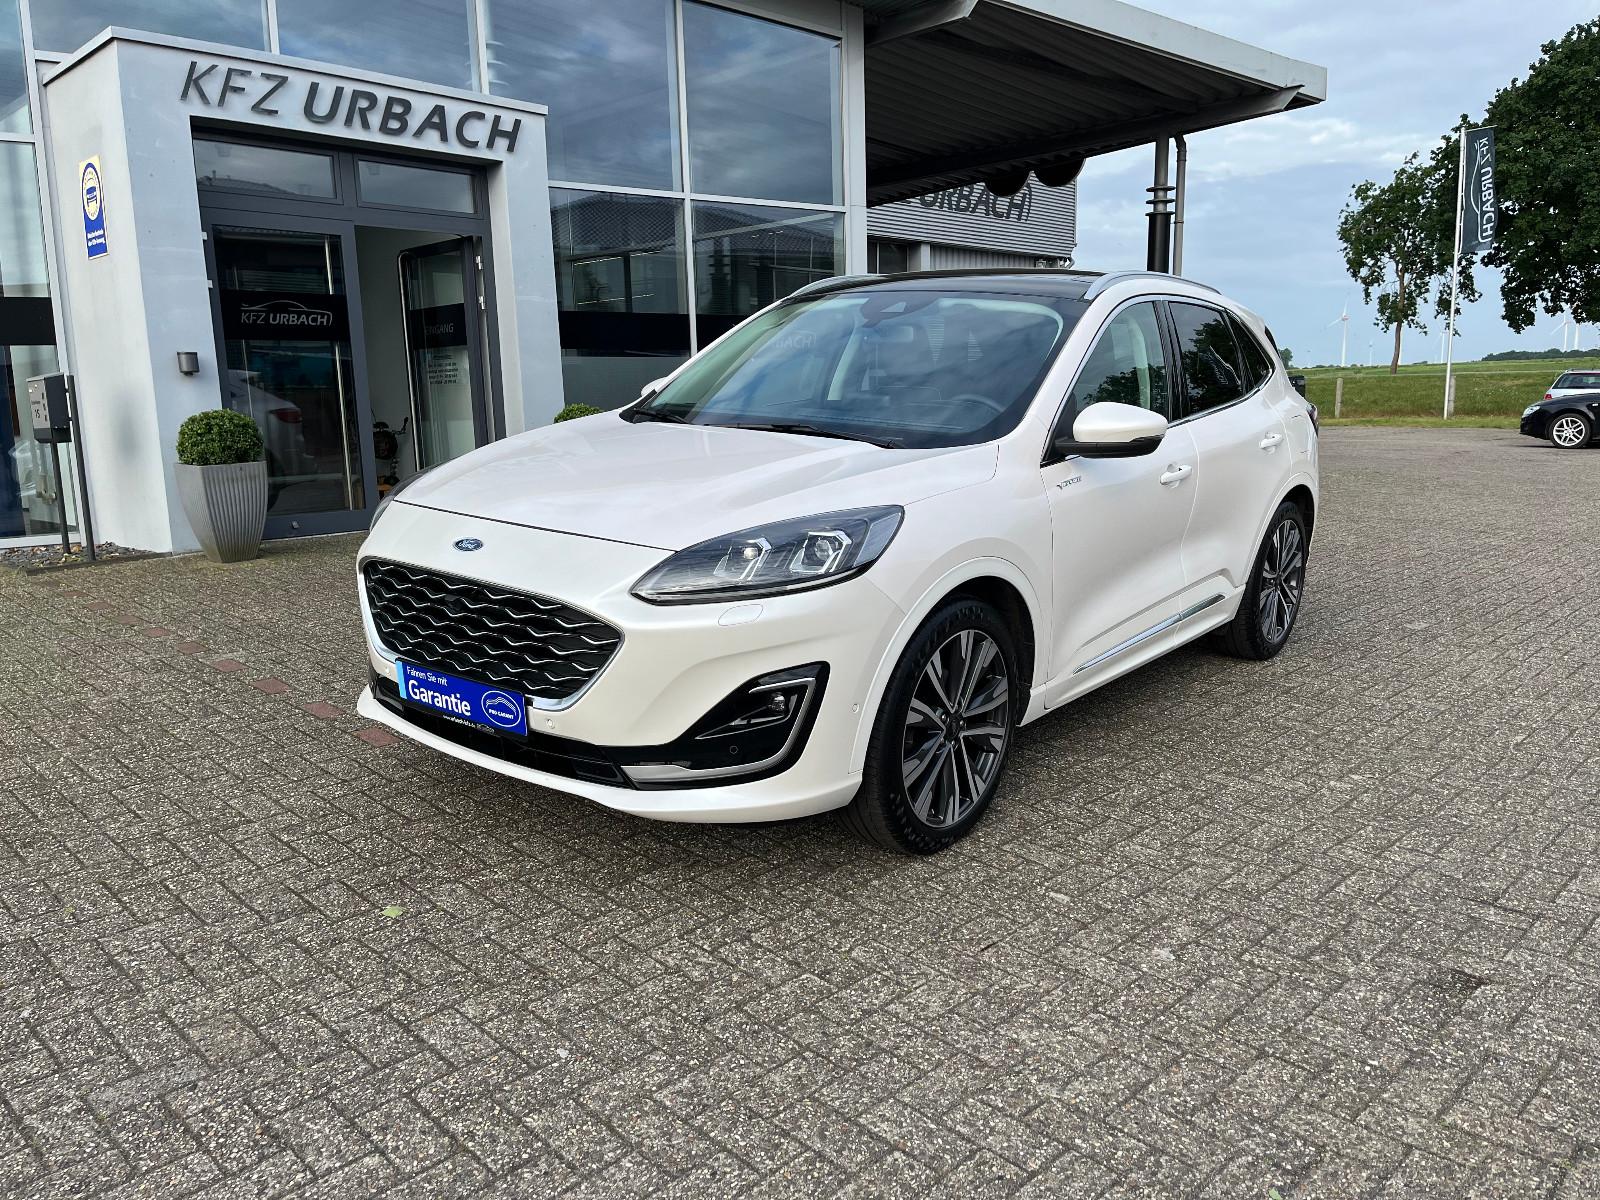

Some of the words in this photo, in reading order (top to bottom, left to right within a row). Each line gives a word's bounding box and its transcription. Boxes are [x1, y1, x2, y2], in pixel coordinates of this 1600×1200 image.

[180, 60, 289, 115] KFZ
[303, 82, 523, 152] URBACH
[241, 312, 266, 324] KFZ
[269, 313, 328, 326] URBACH
[406, 665, 427, 680] Fahren
[427, 672, 437, 683] Sie
[437, 676, 448, 687] mit
[408, 679, 472, 716] Garantie
